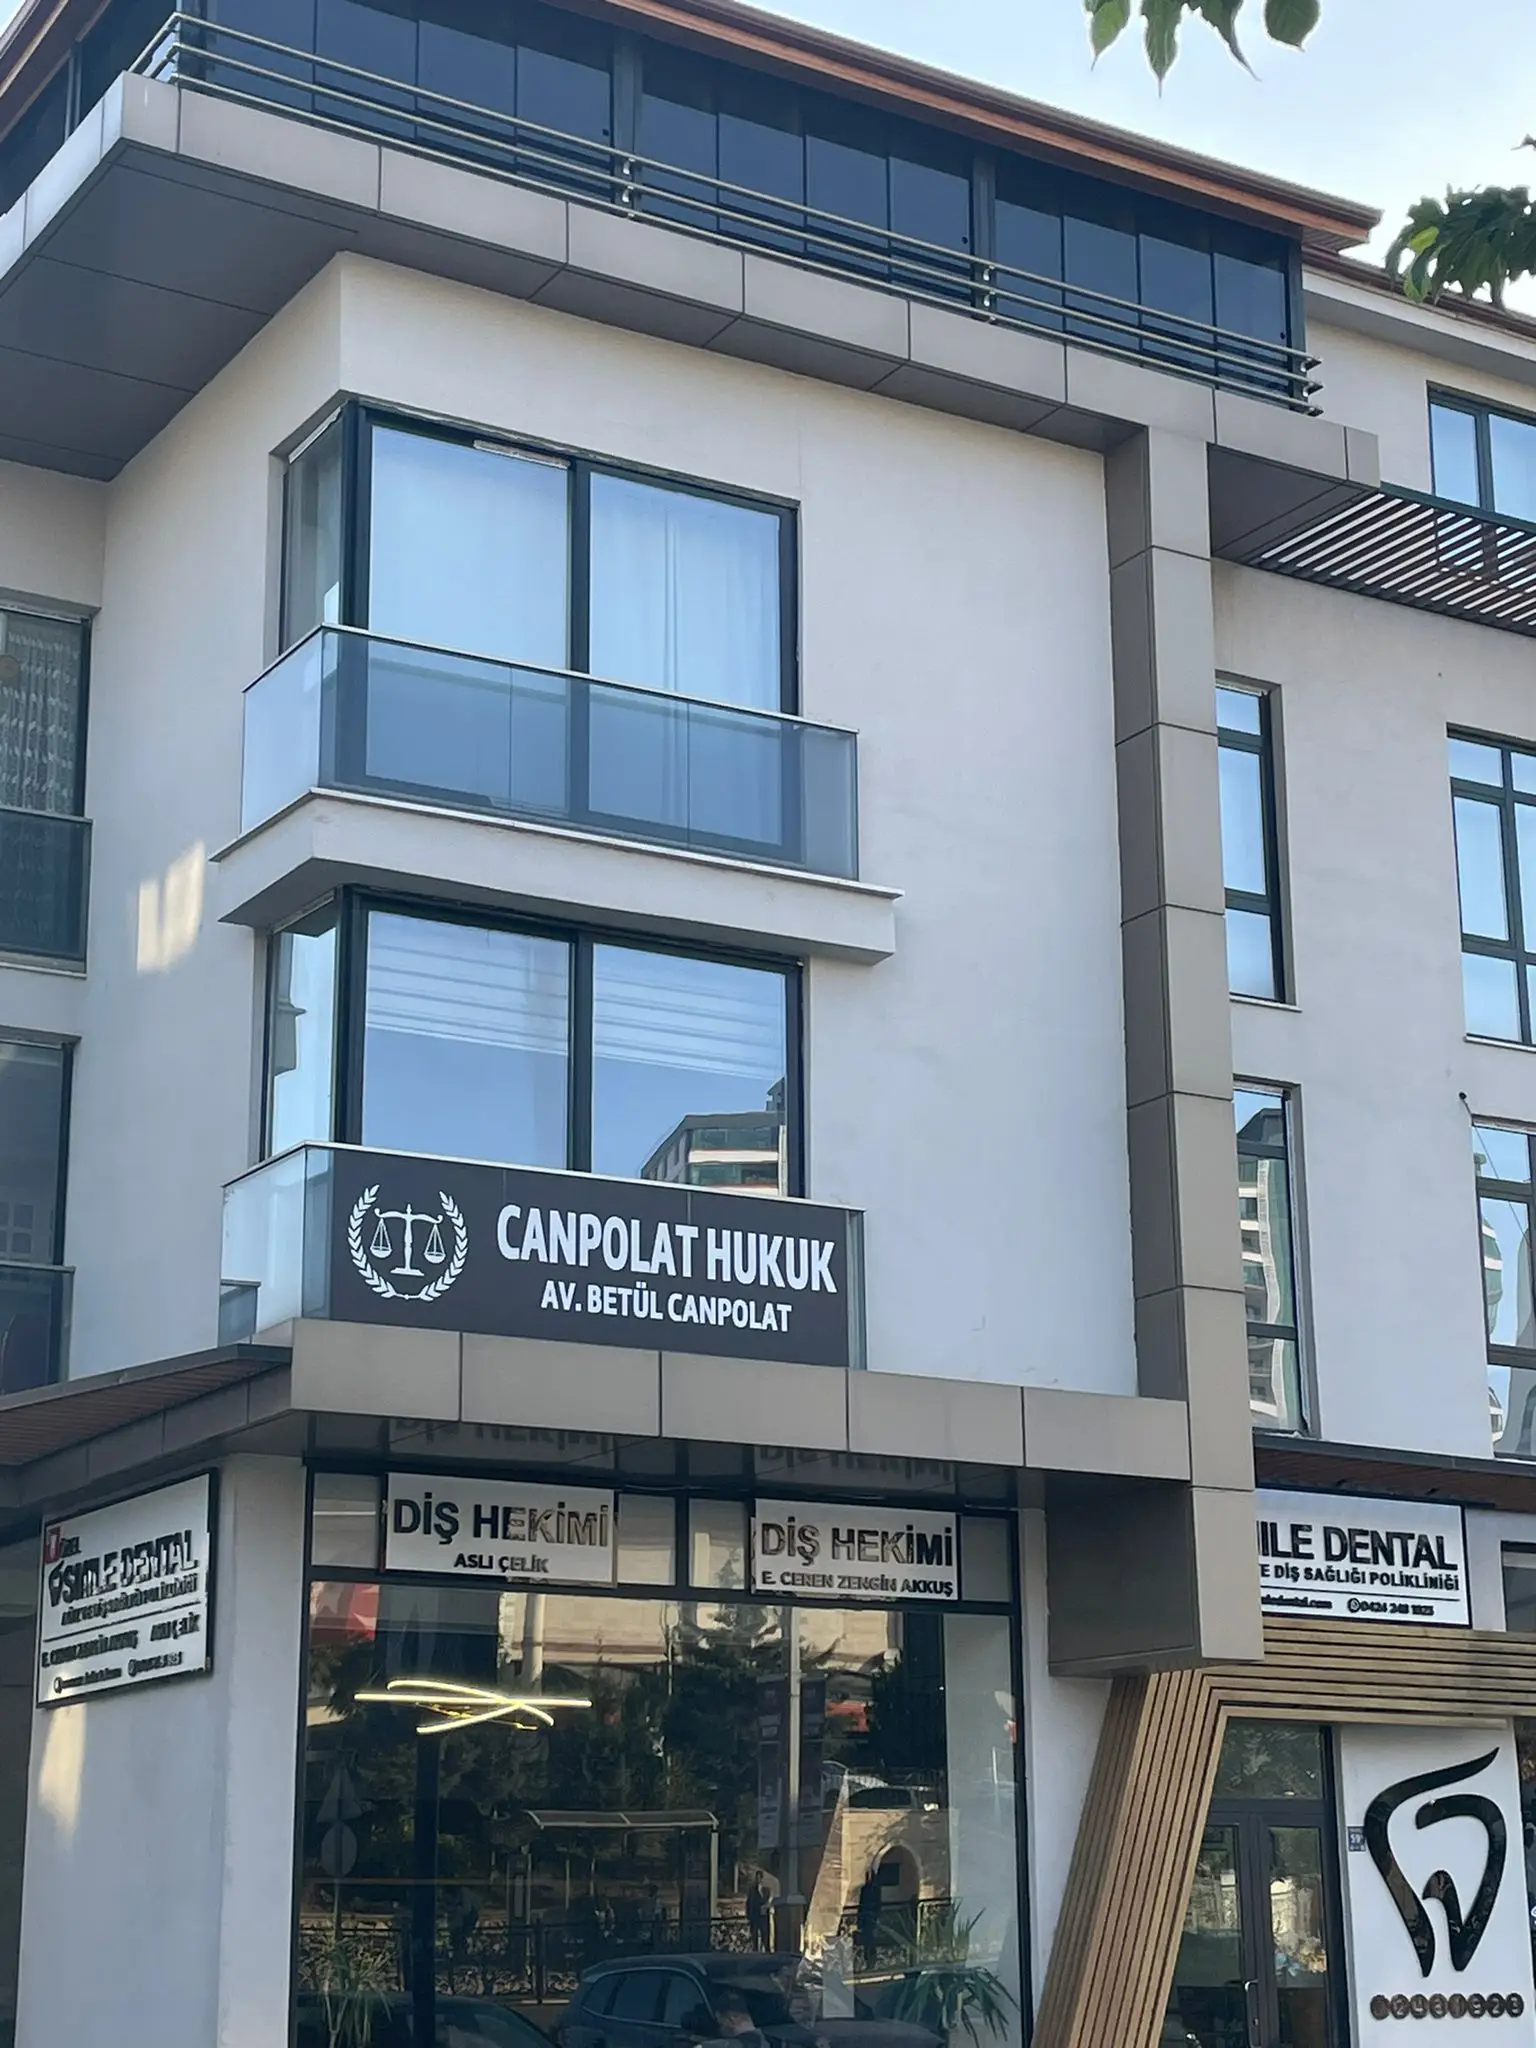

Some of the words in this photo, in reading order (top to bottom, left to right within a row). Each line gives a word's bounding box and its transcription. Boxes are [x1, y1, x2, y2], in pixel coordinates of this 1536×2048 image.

[496, 1203, 699, 1277] CANPOLAT
[706, 1228, 838, 1294] HUKUK
[540, 1281, 582, 1312] AV.
[587, 1281, 663, 1321] BETÜL
[668, 1293, 792, 1333] CANPOLAT
[393, 1492, 460, 1545] DİŞ
[472, 1501, 609, 1547] HEKİMİ
[761, 1516, 820, 1566] DİŞ
[831, 1524, 953, 1567] HEKİMİ
[453, 1552, 494, 1570] ASLI
[498, 1554, 549, 1574] ÇELİK
[1257, 1520, 1315, 1560] ILE
[1322, 1526, 1459, 1571] DENTAL
[780, 1571, 834, 1587] CEREN
[837, 1573, 897, 1593] ZENGİN
[901, 1577, 954, 1597] AKKUŞ
[1274, 1562, 1300, 1583] DİŞ
[1303, 1564, 1367, 1585] SAĞLIĞI
[1370, 1572, 1460, 1592] POLİKLİNİĞİ
